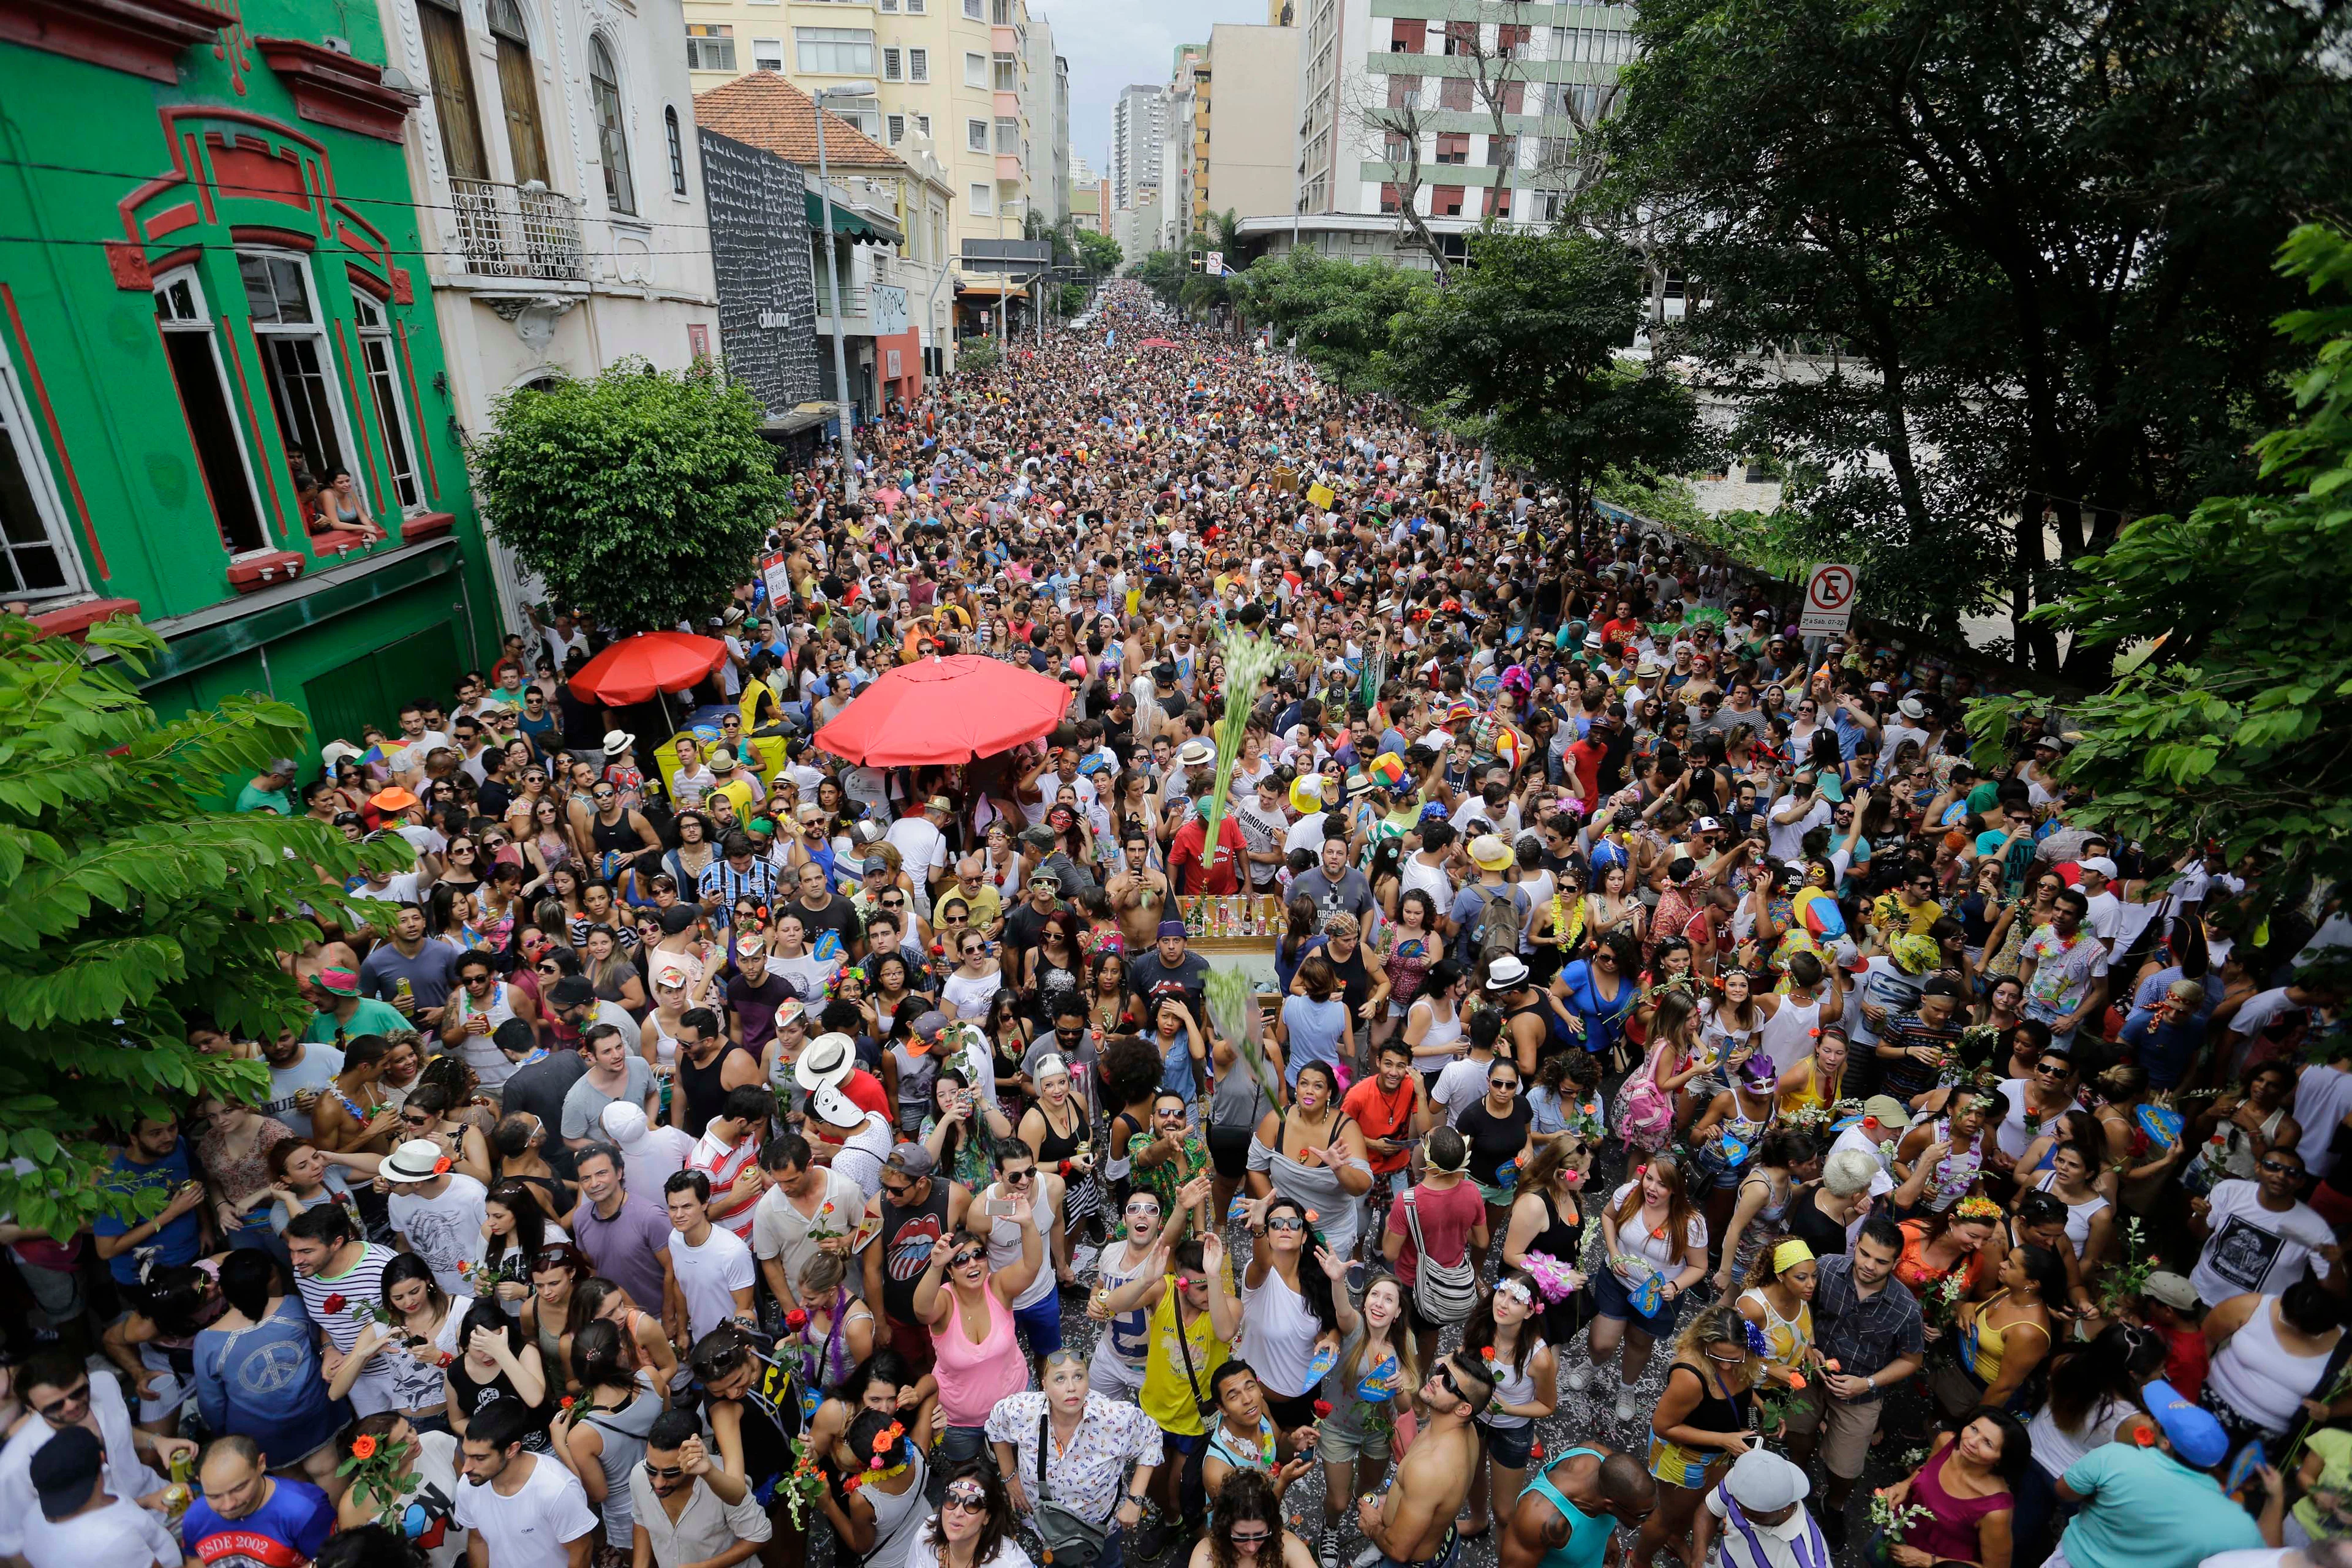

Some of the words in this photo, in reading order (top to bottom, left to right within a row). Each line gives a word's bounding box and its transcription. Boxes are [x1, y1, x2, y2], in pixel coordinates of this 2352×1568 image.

[1823, 575, 1842, 600] E
[1240, 808, 1273, 837] RAMONES
[236, 1535, 269, 1555] 2002
